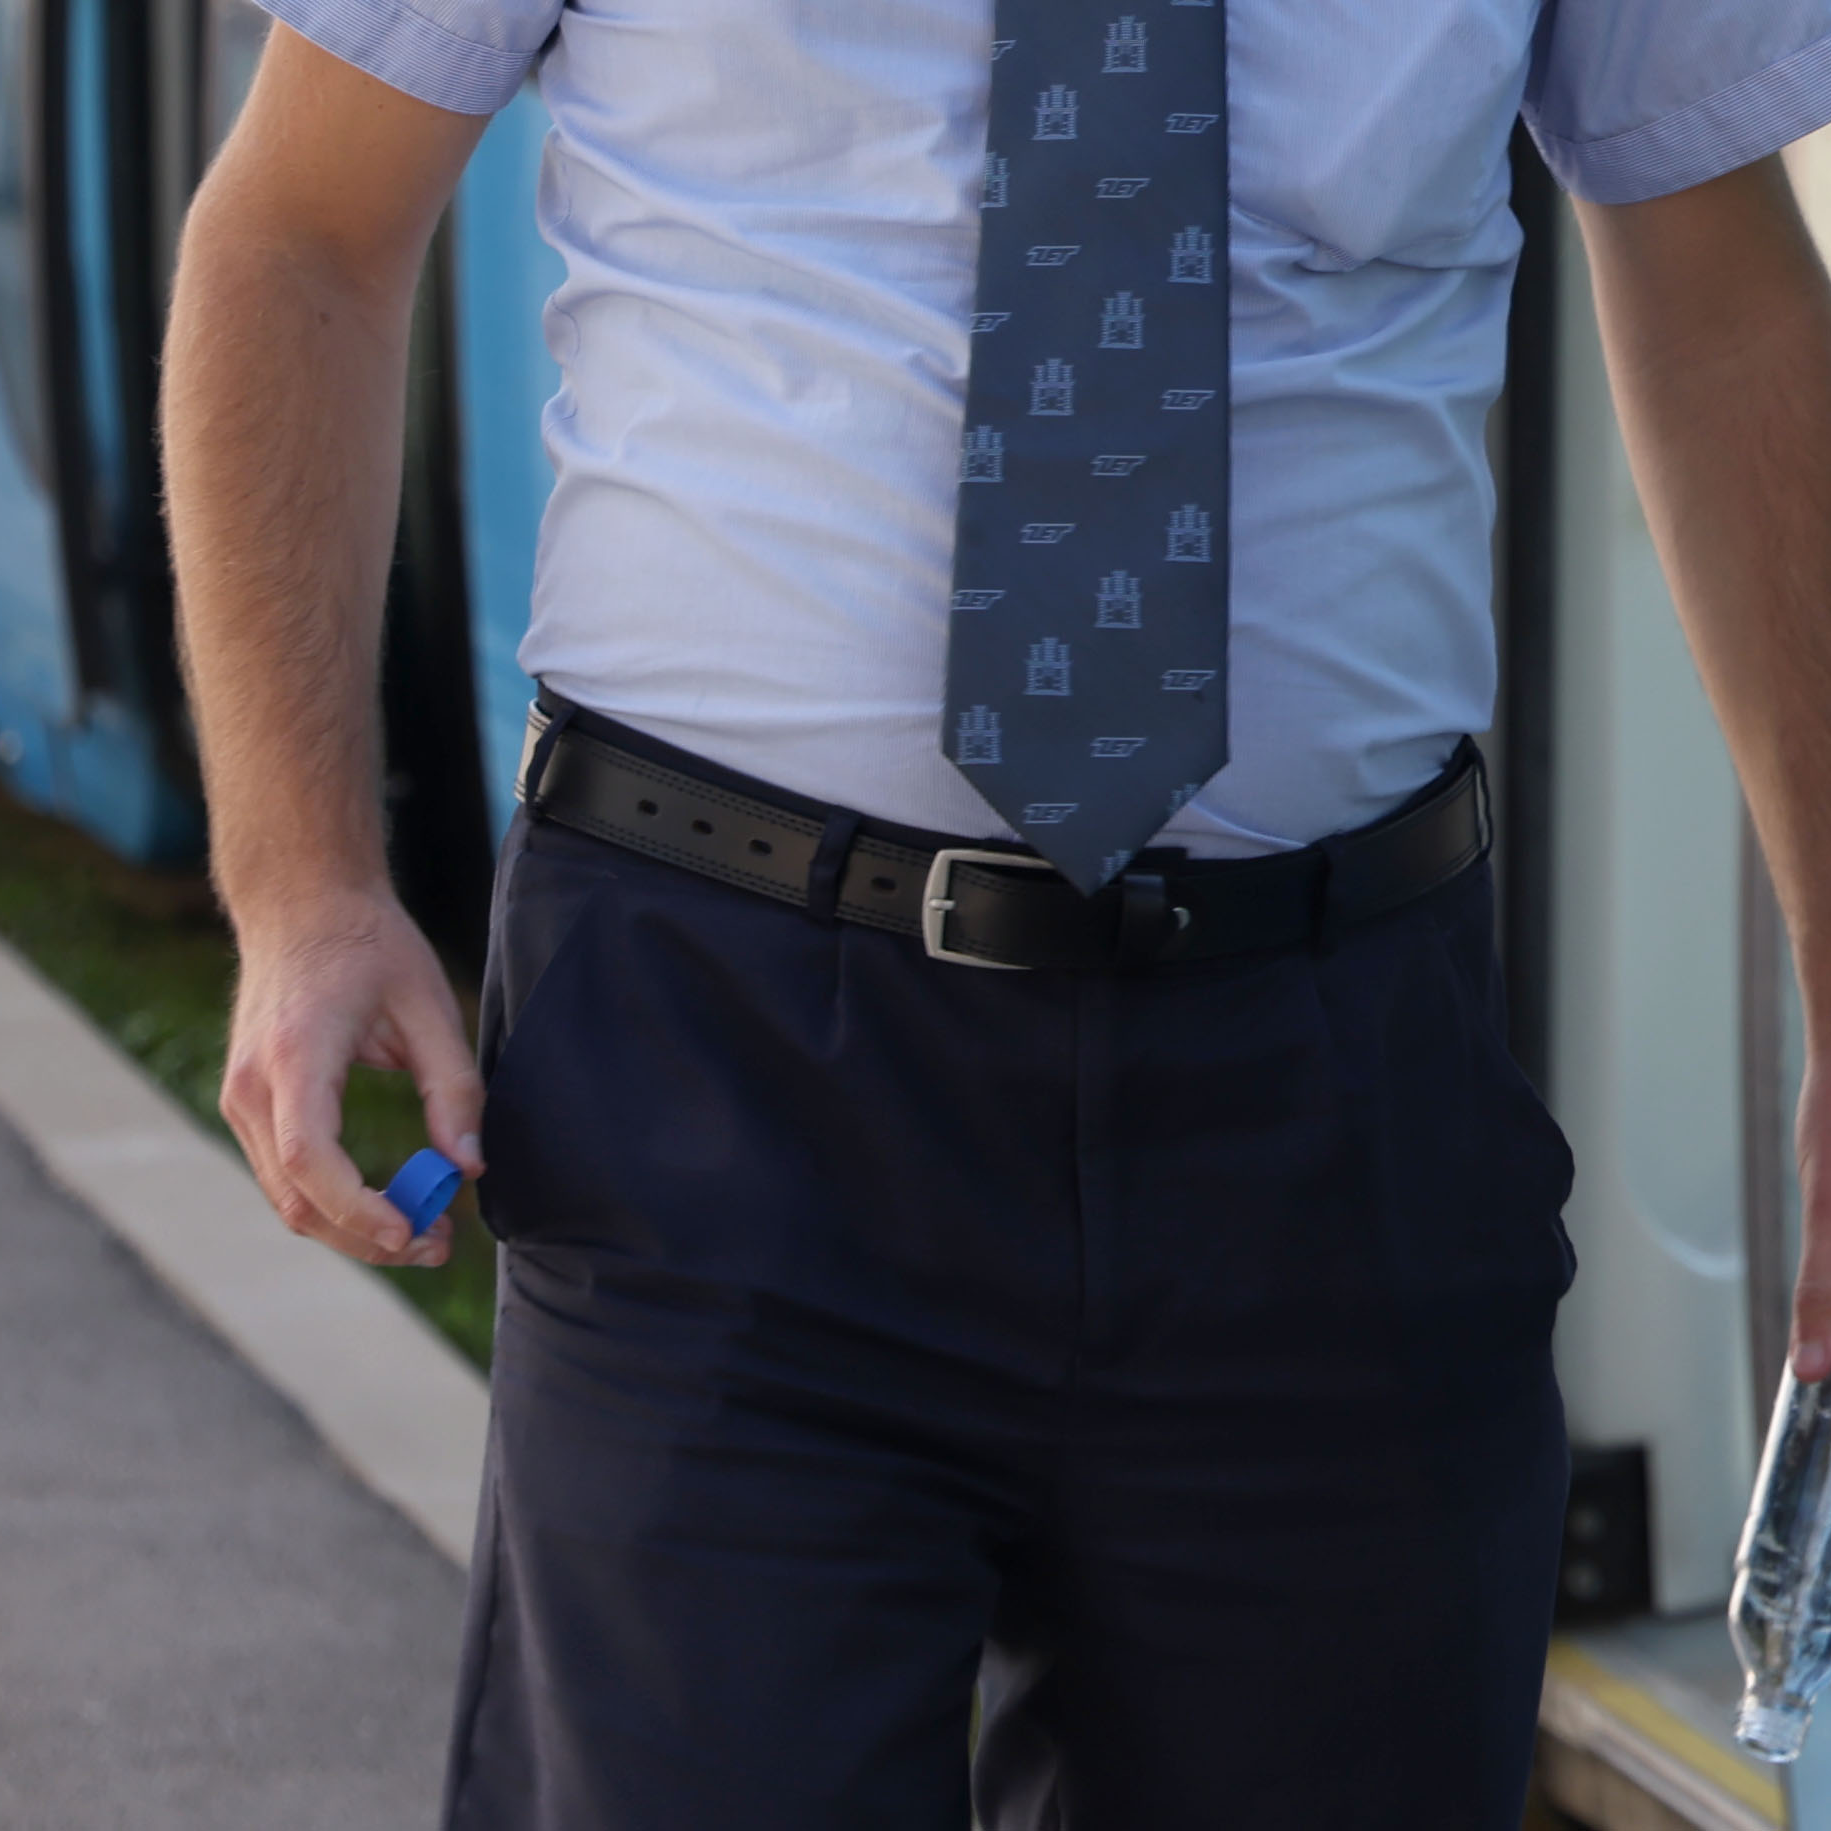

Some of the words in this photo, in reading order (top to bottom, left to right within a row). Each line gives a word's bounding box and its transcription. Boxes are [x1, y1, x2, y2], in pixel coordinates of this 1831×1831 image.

[1166, 113, 1219, 134] ZET
[1096, 177, 1151, 198] ZET
[1026, 245, 1082, 266] ZET
[970, 312, 1013, 334] ET
[1161, 389, 1216, 410] ZET
[1090, 455, 1147, 476] ZET
[1020, 523, 1076, 544] ZET
[1161, 669, 1217, 690] ZET
[1090, 737, 1147, 757] ZET
[1023, 803, 1080, 824] ZET
